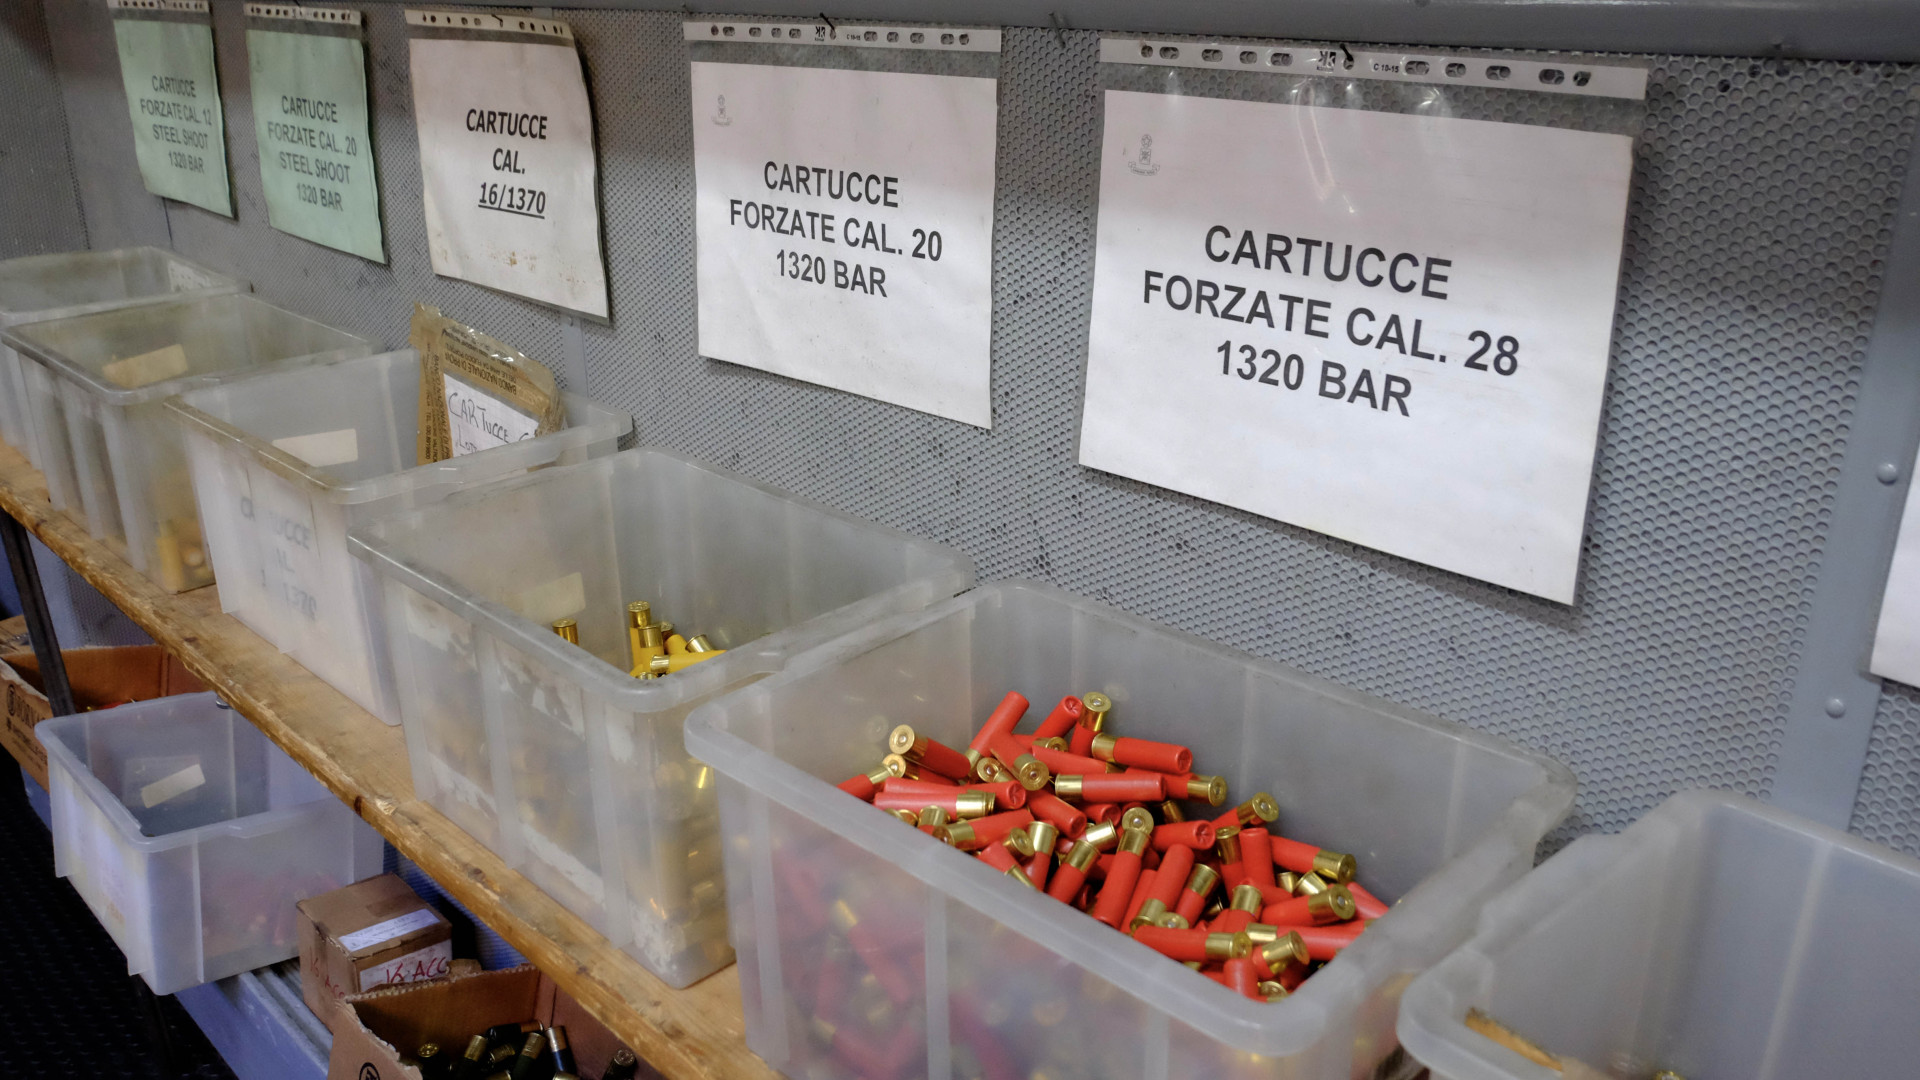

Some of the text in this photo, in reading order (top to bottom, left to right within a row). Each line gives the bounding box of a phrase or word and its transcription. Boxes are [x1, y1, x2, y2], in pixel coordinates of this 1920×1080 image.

[1381, 64, 1400, 73] 10-15
[152, 75, 196, 98] CARTUCCE
[140, 98, 182, 120] FORZATE
[202, 107, 212, 126] 12
[282, 95, 338, 123] CARTUCCE
[466, 108, 548, 140] CARTUCCE
[153, 124, 208, 149] STEEL SHOOT
[267, 121, 317, 149] FORZATE
[345, 135, 357, 157] 20
[168, 150, 204, 174] 1320 BAR
[280, 151, 350, 184] STEEL SHOOT
[492, 147, 525, 175] CAL.
[296, 182, 344, 212] 1320 BAR
[478, 181, 546, 215] 16/1370
[764, 160, 899, 208] CARTUCCE
[730, 199, 943, 262] FORZATE CAL. 20
[776, 248, 888, 298] 1320 BAR
[1204, 224, 1452, 301] CARTUCCE
[1143, 269, 1520, 376] FORZATE CAL. 28
[1216, 339, 1413, 418] 1320 BAR
[449, 392, 509, 444] CARTUCCE
[412, 957, 447, 982] ACC
